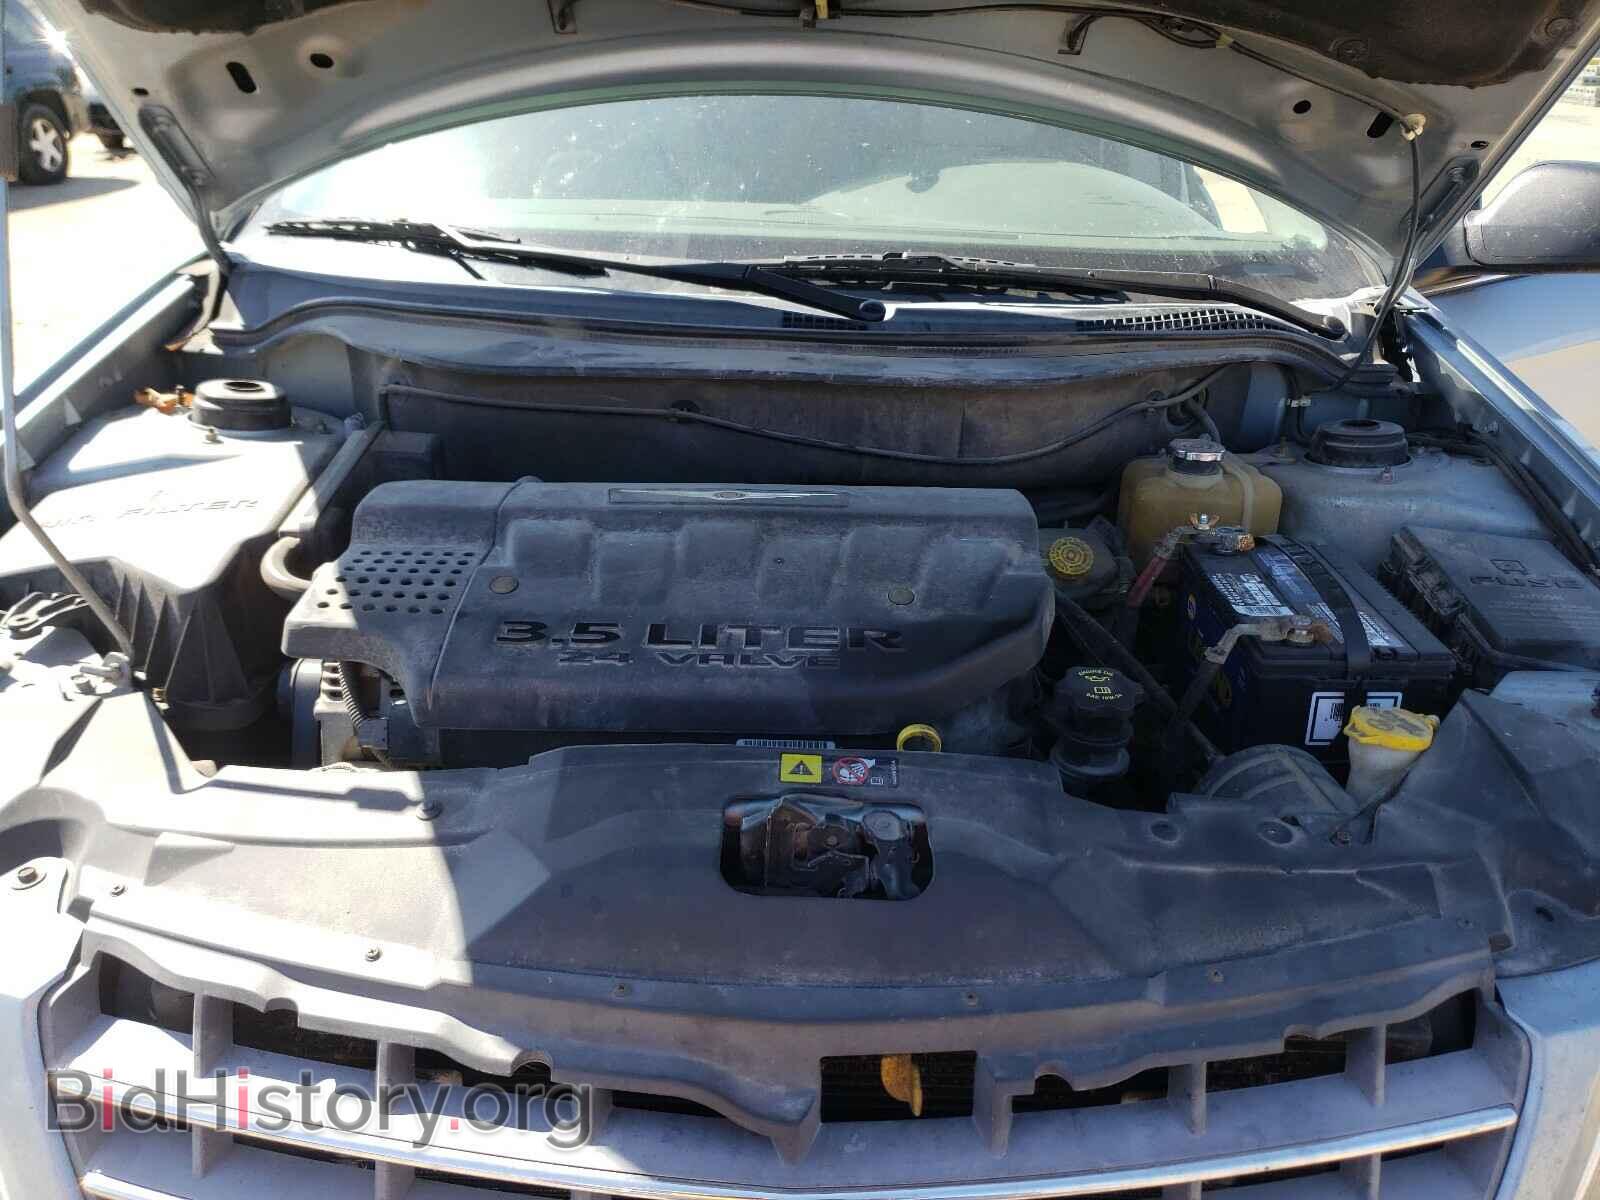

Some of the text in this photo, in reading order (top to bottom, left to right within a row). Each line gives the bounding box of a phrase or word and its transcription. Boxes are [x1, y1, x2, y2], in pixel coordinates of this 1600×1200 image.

[116, 499, 259, 520] FILTER
[495, 620, 906, 651] 3.5 LITER
[556, 651, 841, 669] 24 VALVE
